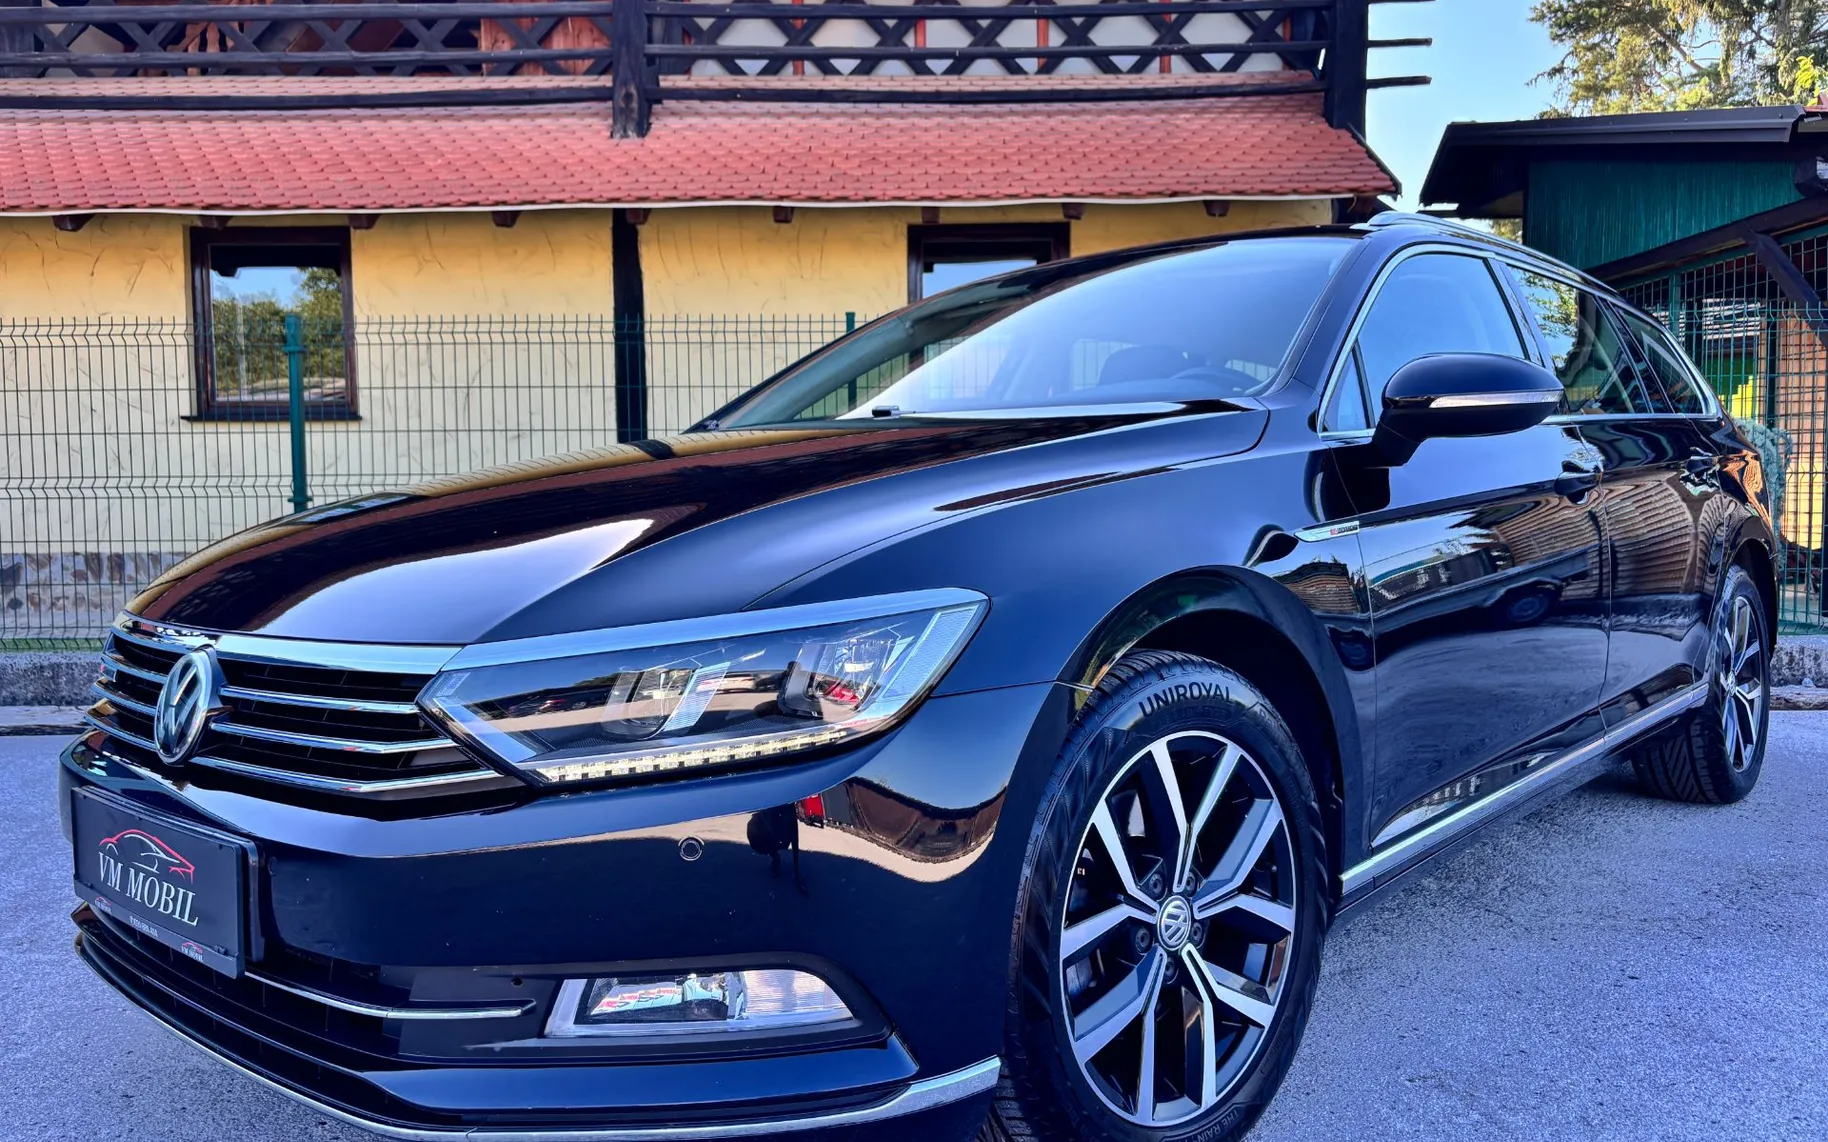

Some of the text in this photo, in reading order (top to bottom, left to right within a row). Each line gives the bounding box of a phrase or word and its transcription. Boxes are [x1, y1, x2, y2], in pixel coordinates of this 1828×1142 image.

[1138, 681, 1232, 718] UNIROYAL
[98, 851, 198, 926] VM MOBIL
[1220, 1108, 1239, 1127] THE
